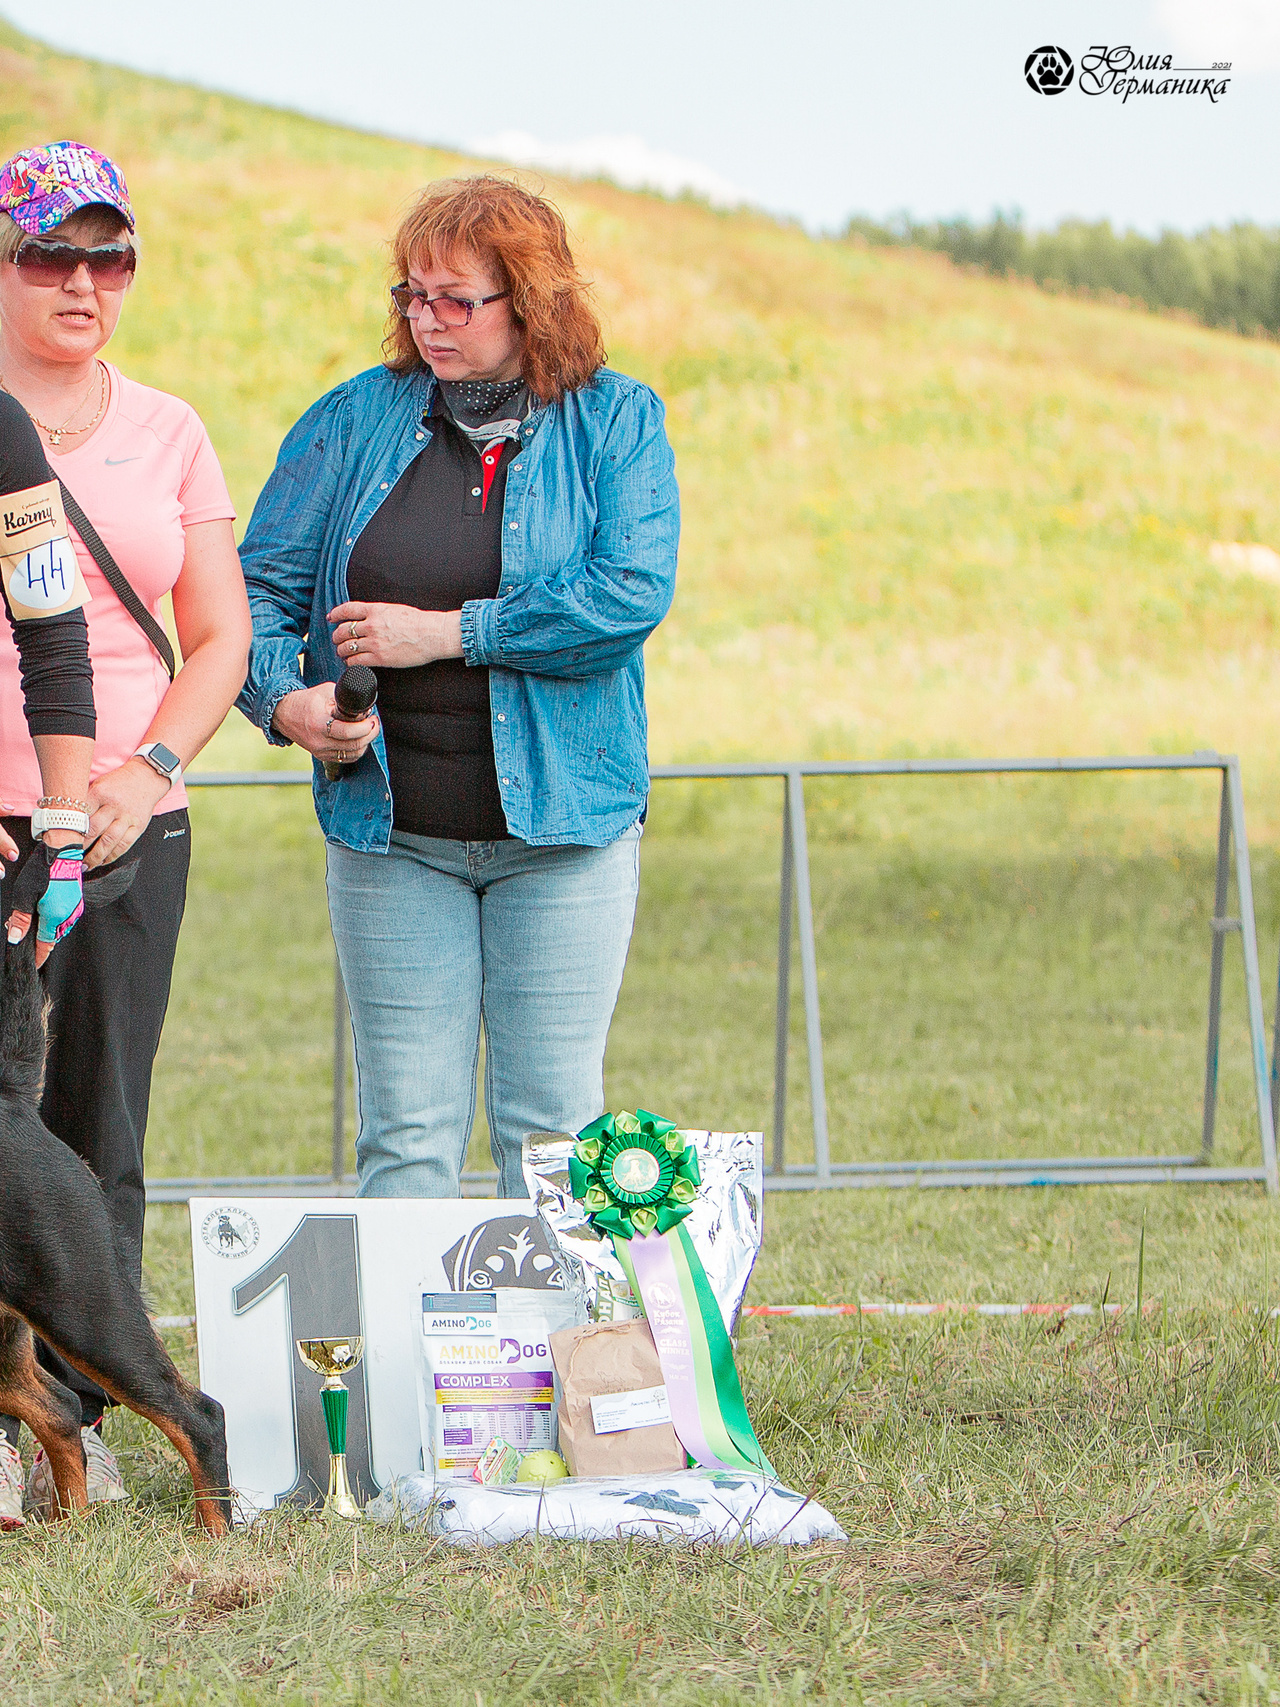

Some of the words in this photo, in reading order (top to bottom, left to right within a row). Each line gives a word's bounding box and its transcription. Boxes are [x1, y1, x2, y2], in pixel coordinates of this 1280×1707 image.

[3, 507, 57, 532] Karmy
[26, 539, 66, 598] 44
[232, 1213, 382, 1511] 1
[440, 1374, 511, 1388] COMPLEX
